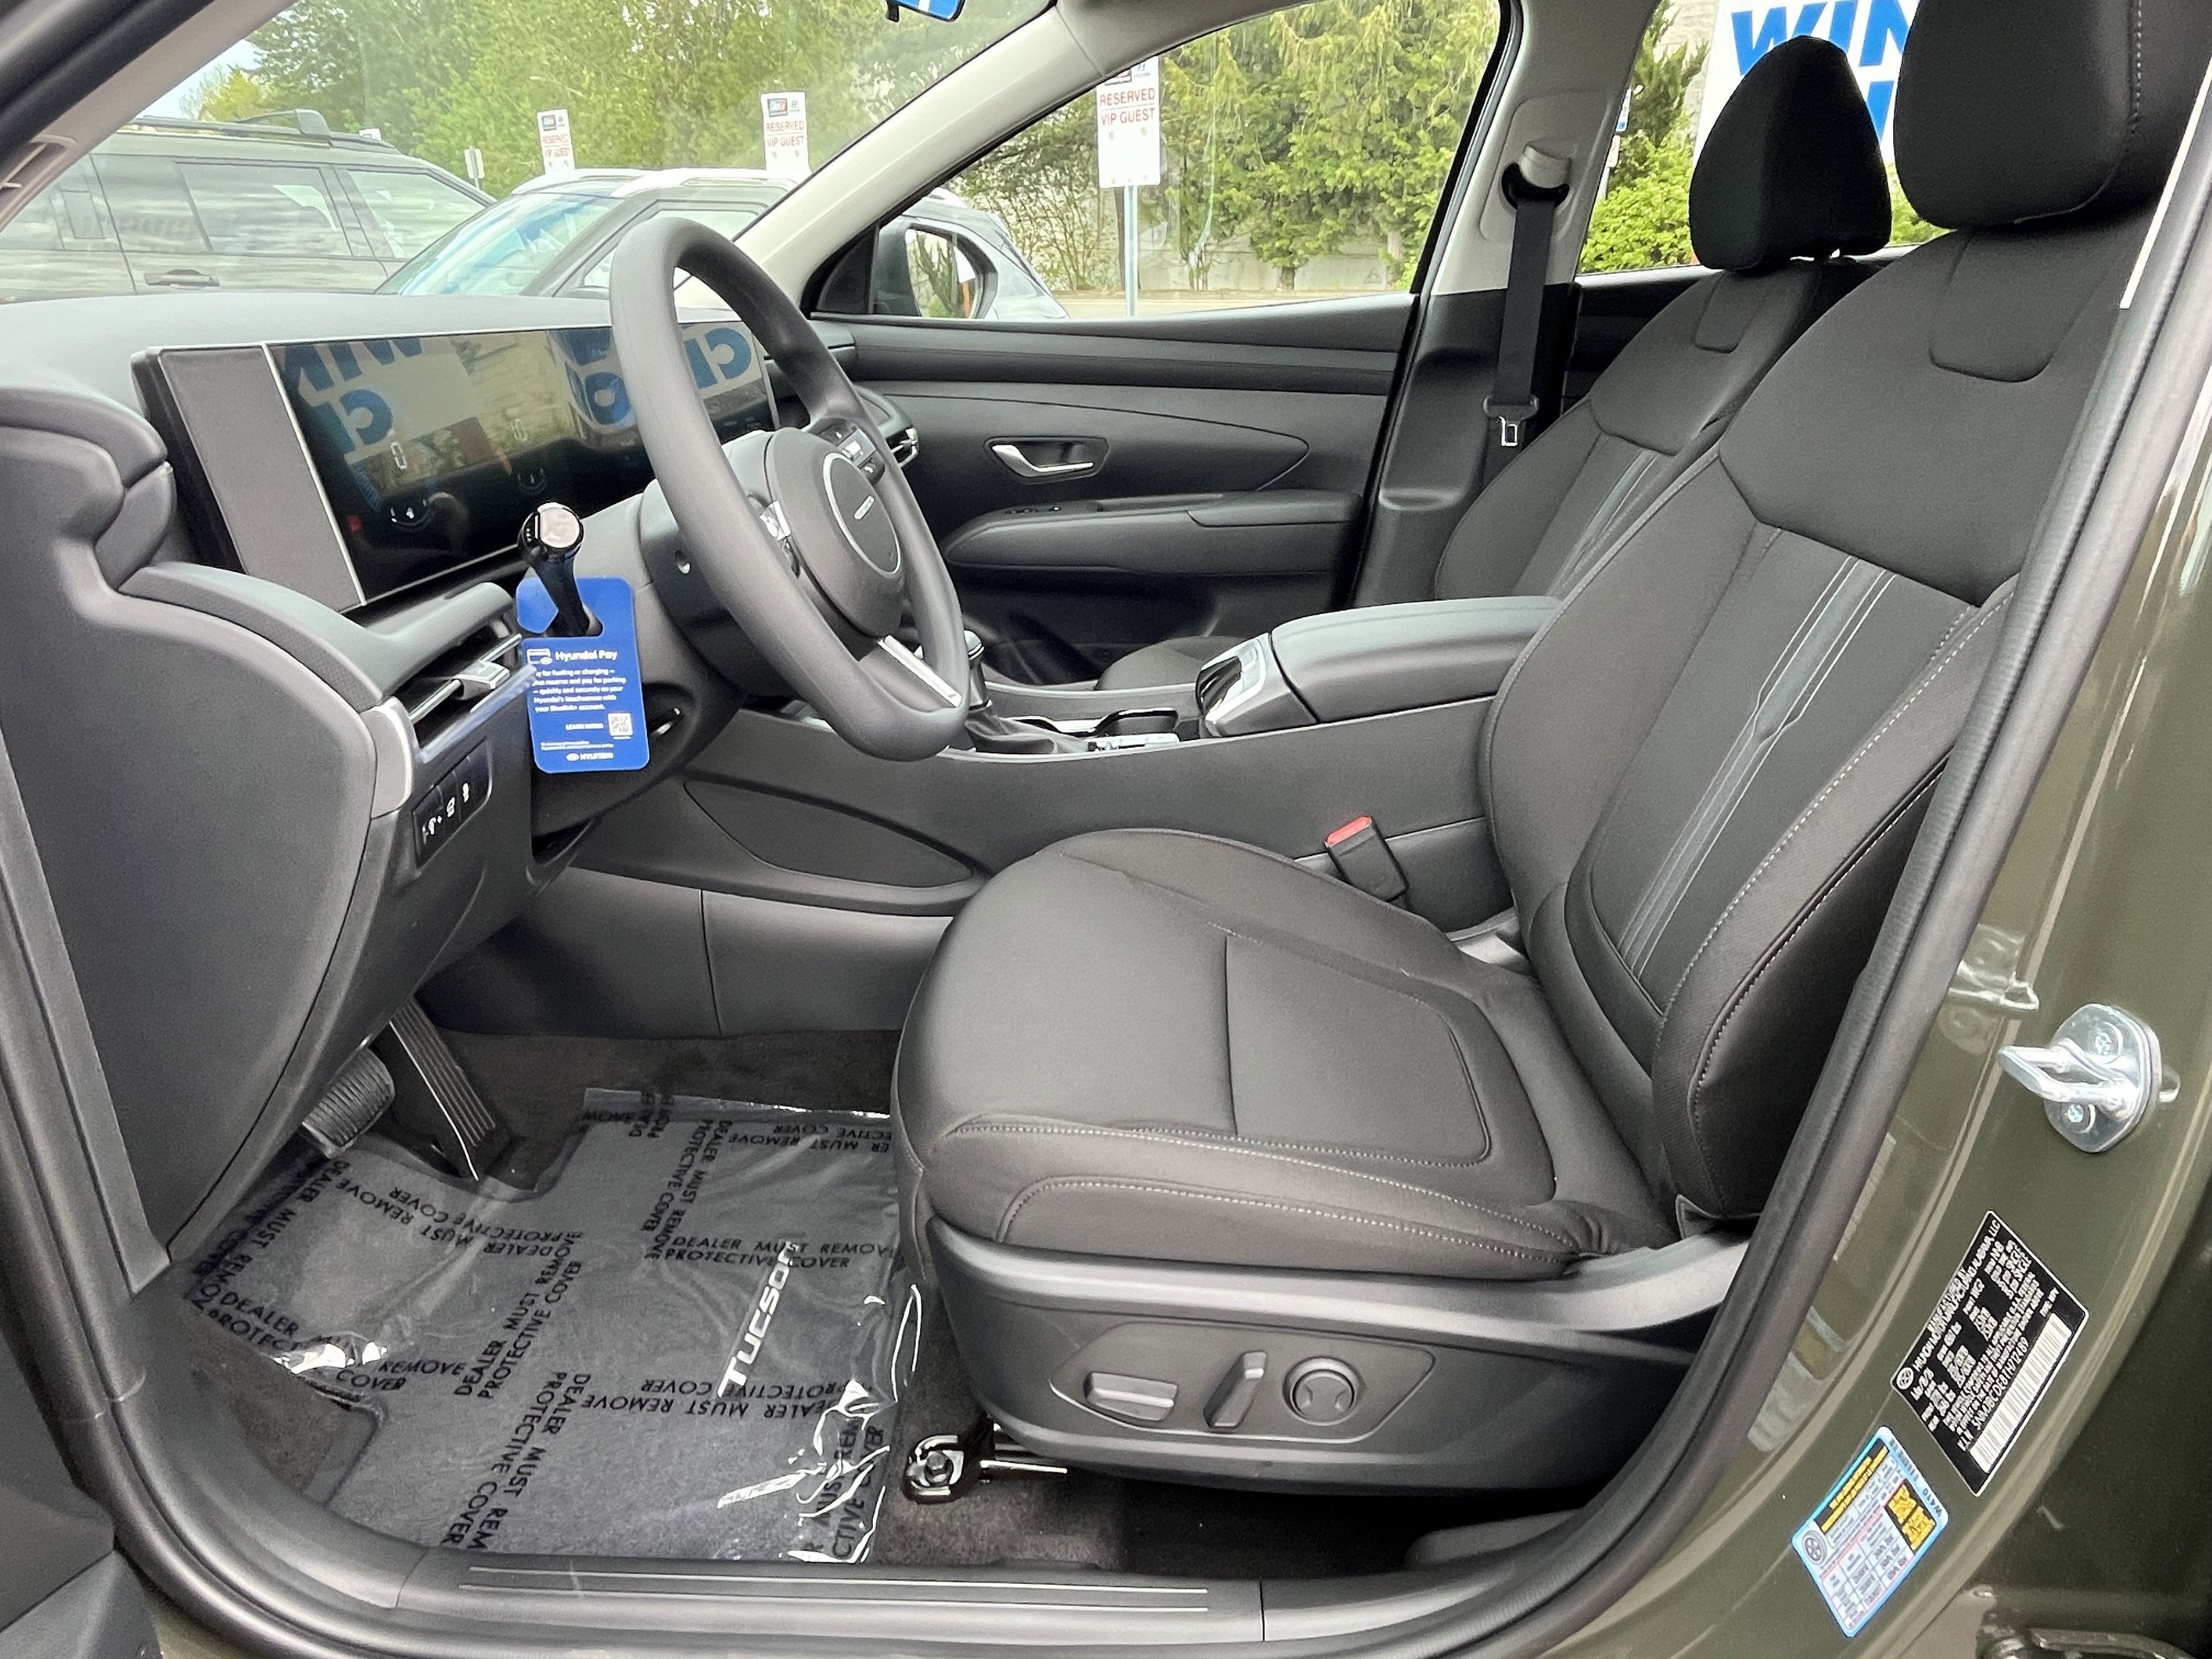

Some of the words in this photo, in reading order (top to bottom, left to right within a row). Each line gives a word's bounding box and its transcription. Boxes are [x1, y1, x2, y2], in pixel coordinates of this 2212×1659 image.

[1100, 88, 1155, 106] RESERVED
[766, 121, 804, 132] RESERVED
[1101, 112, 1116, 126] VIP
[1120, 108, 1155, 123] GUEST
[767, 137, 778, 146] VIP
[781, 136, 804, 146] GUEST
[555, 650, 598, 663] Hyundai
[599, 650, 618, 661] Pay
[680, 1170, 707, 1204] MUST
[335, 1178, 414, 1225] REMOVE
[389, 1187, 449, 1223] COVER
[251, 1208, 296, 1249] MUST
[420, 1224, 475, 1249] MUST
[484, 1243, 553, 1256] DEALER
[674, 1237, 741, 1250] DEALER
[754, 1240, 809, 1254] MUST
[789, 1256, 851, 1268] COVER
[220, 1291, 300, 1337] DEALER
[477, 1309, 551, 1398] PROTECTIVE
[544, 1261, 583, 1304] COVER
[454, 1340, 507, 1396] DEALER
[503, 1292, 540, 1330] MUST
[379, 1358, 467, 1375] REMOVE
[336, 1369, 407, 1391] COVER
[641, 1378, 713, 1393] COVER
[541, 1373, 591, 1435] DEALER
[580, 1393, 675, 1414] REMOVE
[685, 1398, 750, 1419] MUST
[491, 1371, 567, 1474] PROTECTIVE
[503, 1446, 548, 1498] MUST
[439, 1480, 498, 1546] COVER
